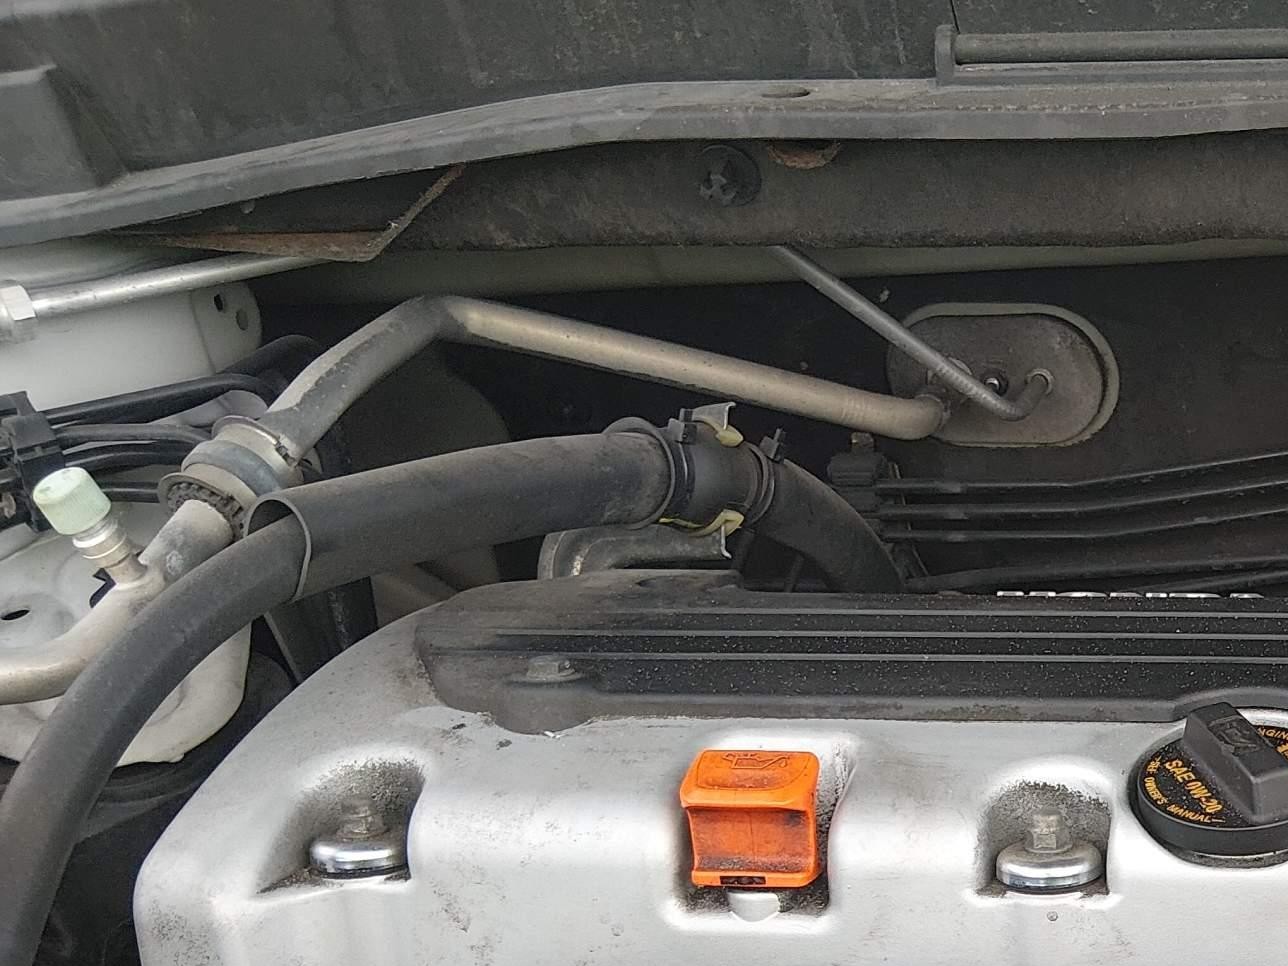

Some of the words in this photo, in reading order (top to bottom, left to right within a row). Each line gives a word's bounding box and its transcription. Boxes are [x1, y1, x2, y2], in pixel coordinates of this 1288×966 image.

[1143, 776, 1168, 806] OWNER'S
[1166, 805, 1212, 824] MANUAL
[1164, 759, 1194, 784] SAE
[1184, 778, 1223, 814] 0W-20
